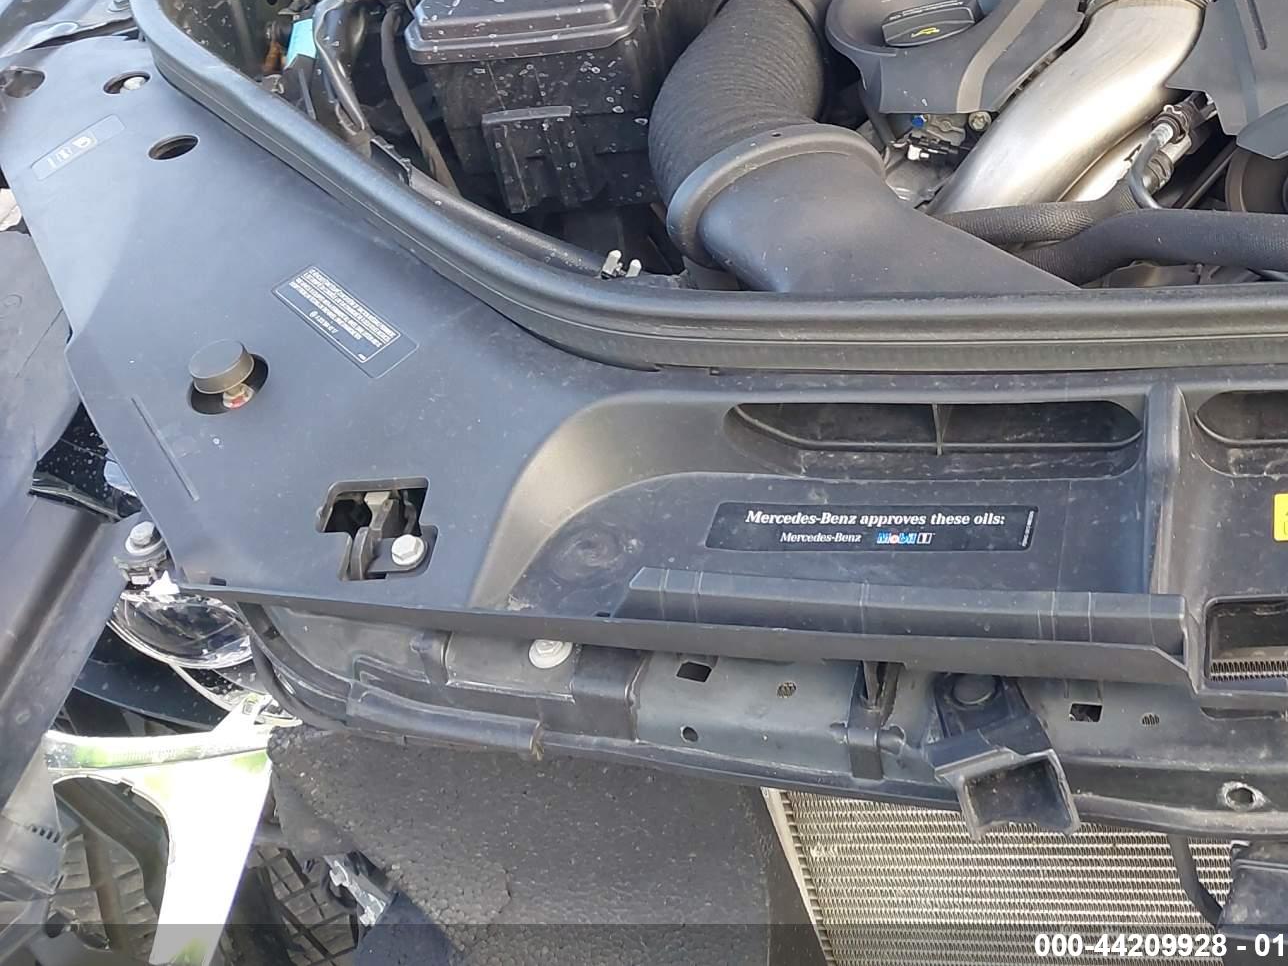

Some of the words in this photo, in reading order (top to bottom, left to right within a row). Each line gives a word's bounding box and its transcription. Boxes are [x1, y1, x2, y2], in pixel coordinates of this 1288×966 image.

[745, 510, 857, 525] Mercedes-Benz
[859, 514, 927, 527] approves
[931, 512, 970, 525] these
[973, 512, 1005, 525] oils:
[780, 532, 862, 543] Mercedes-Benz
[877, 532, 917, 544] Mobil
